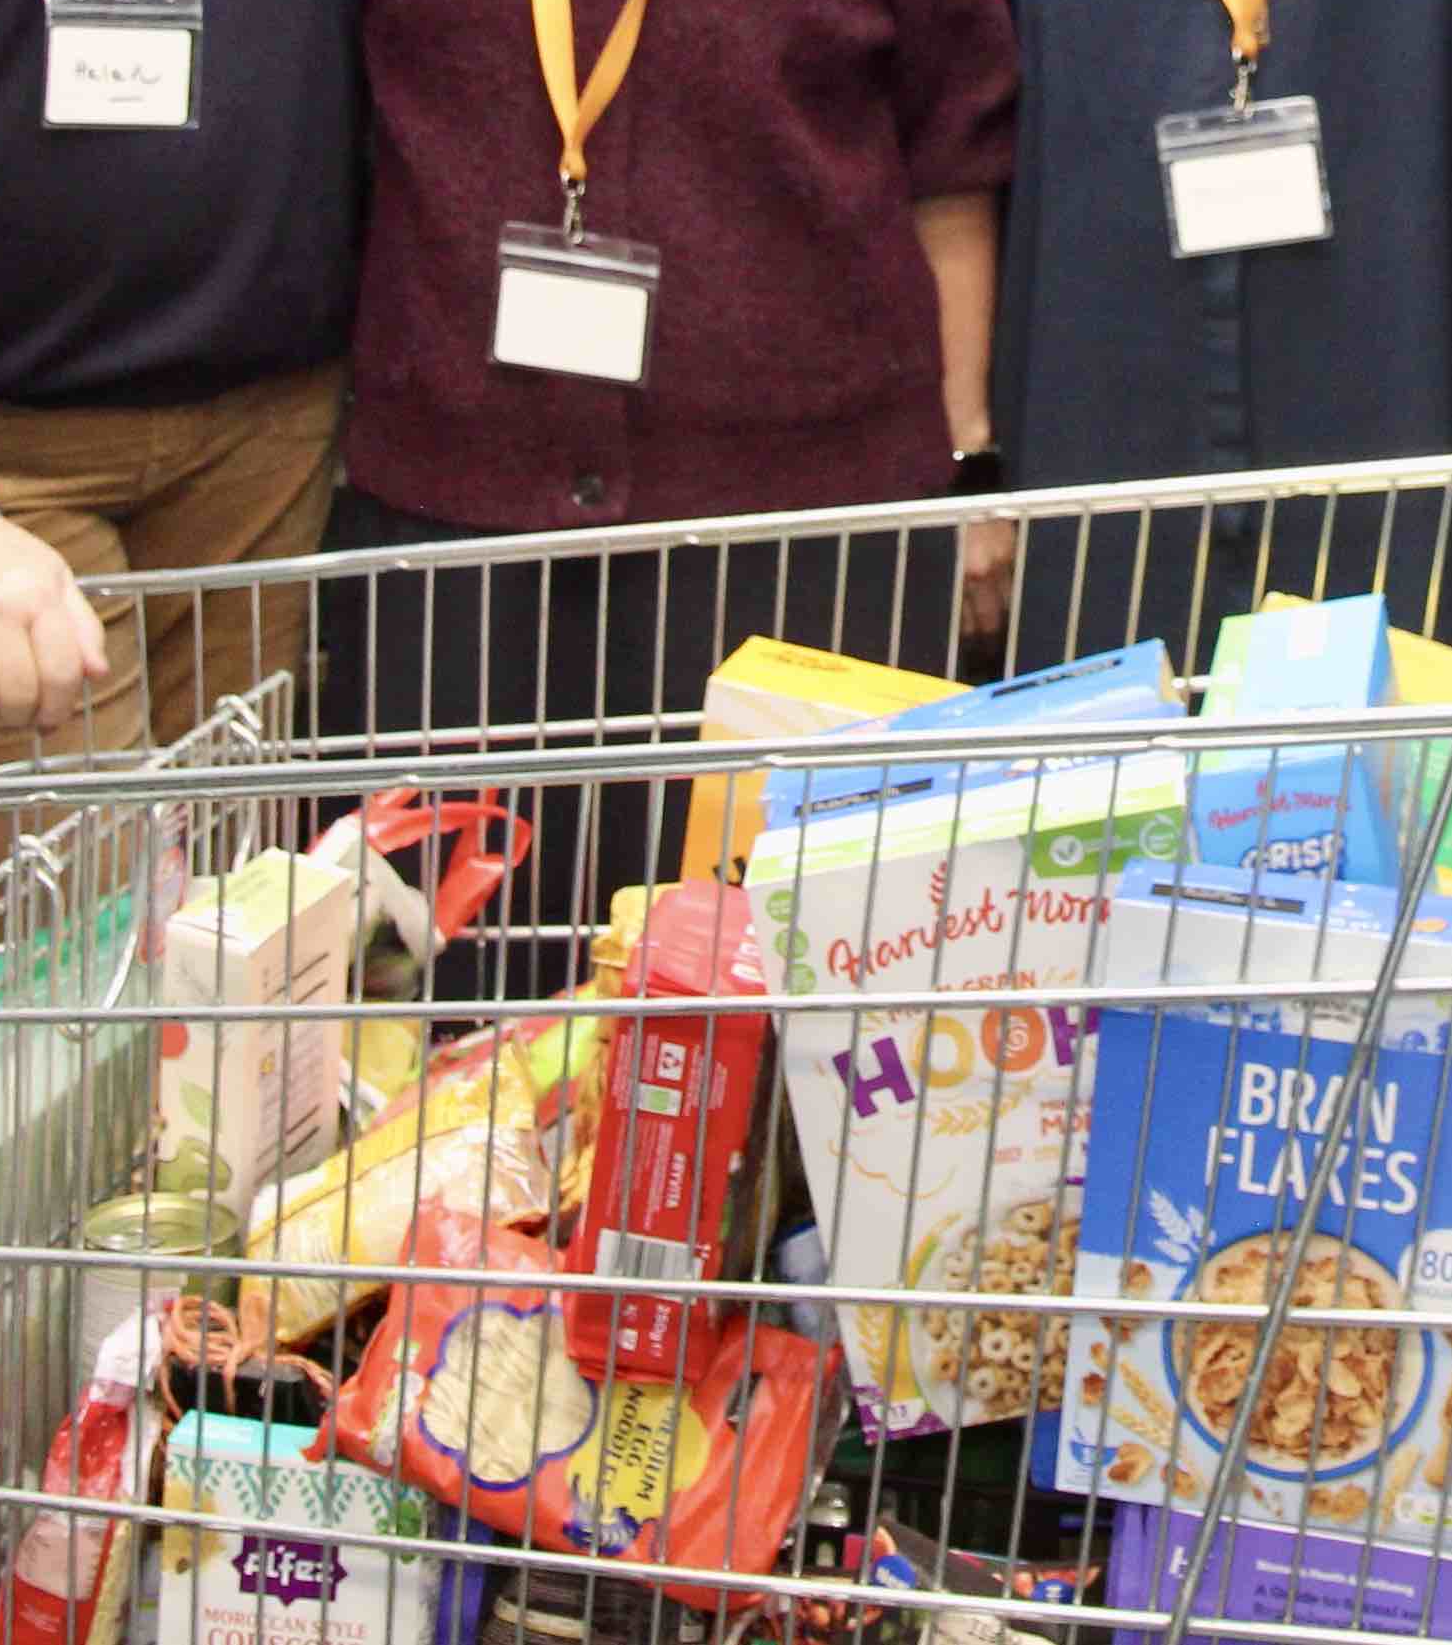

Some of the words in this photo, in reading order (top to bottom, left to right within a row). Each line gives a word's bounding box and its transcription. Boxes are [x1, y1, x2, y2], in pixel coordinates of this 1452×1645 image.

[826, 886, 1003, 988] Harvest
[1238, 1062, 1399, 1144] BRAN
[1204, 1126, 1419, 1215] FLAKES
[625, 1423, 652, 1469] EGG
[204, 1606, 307, 1632] MOROCAN
